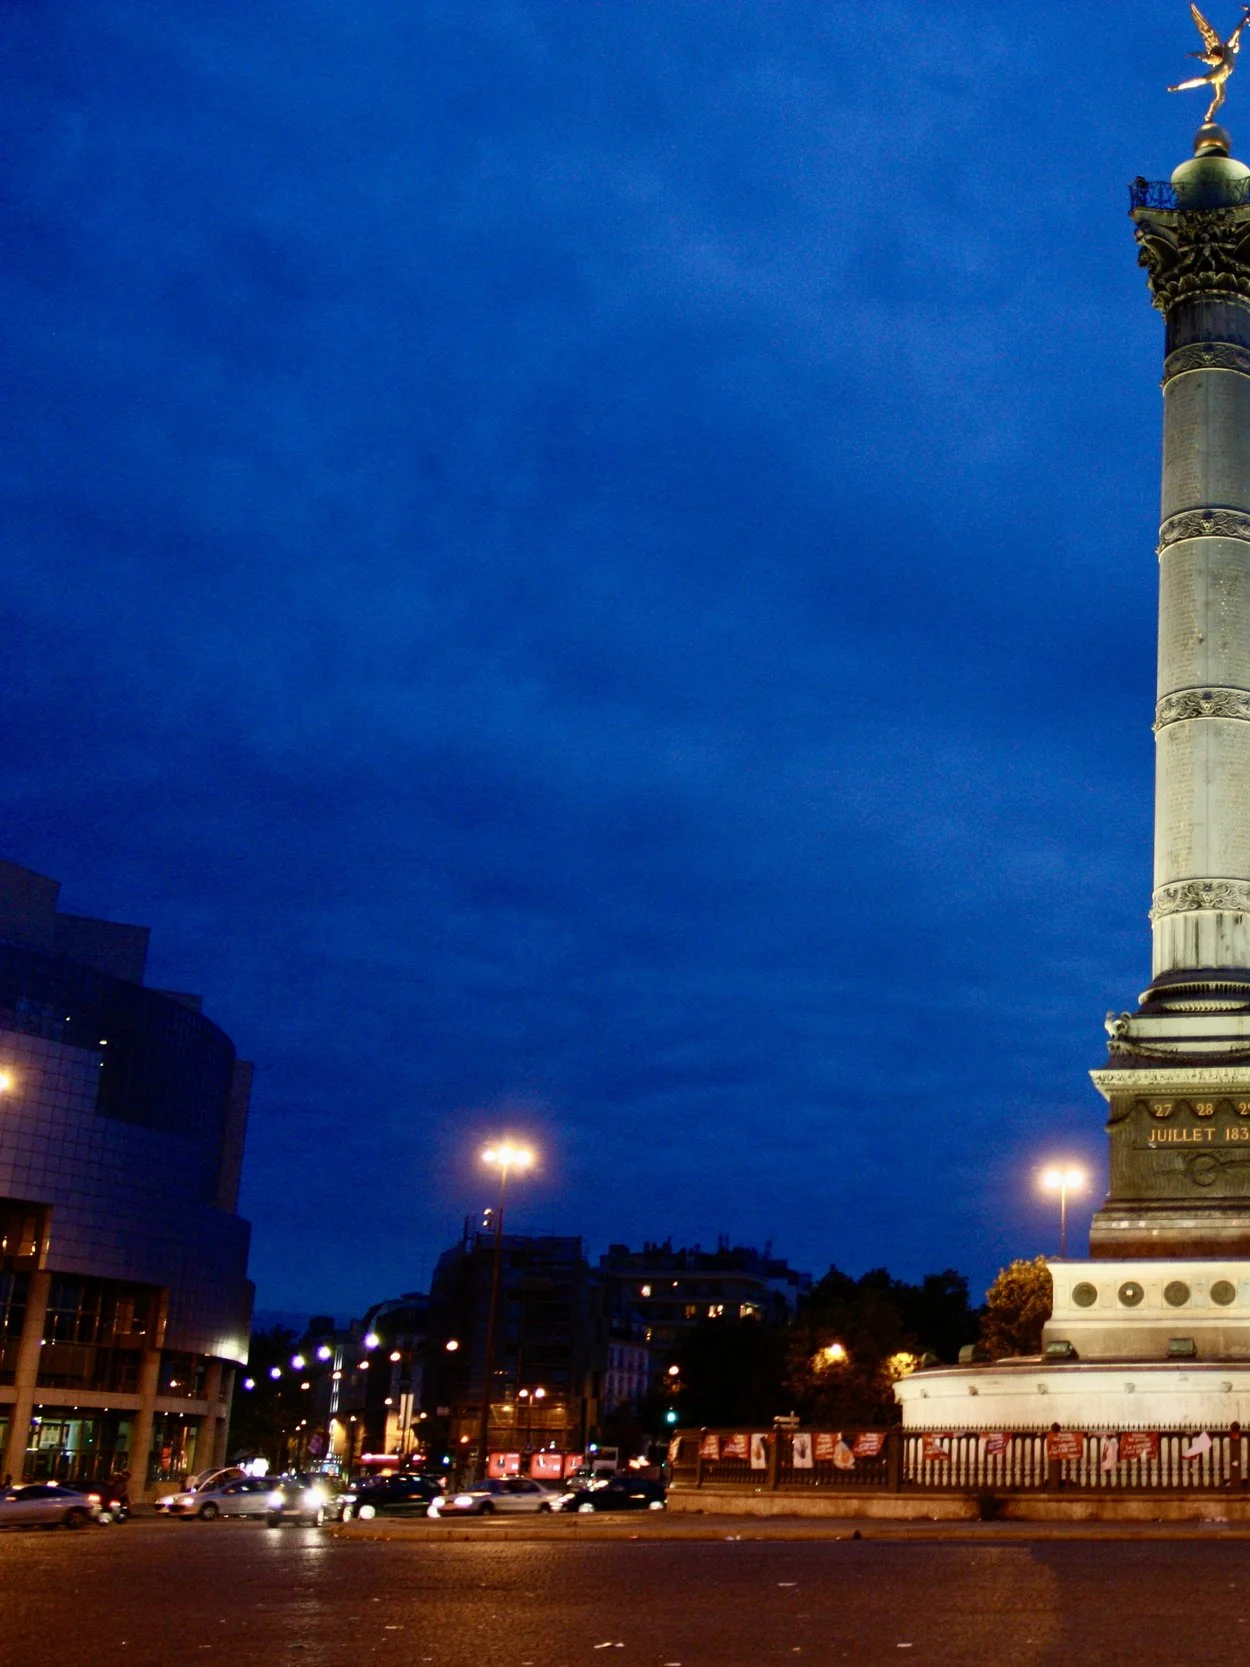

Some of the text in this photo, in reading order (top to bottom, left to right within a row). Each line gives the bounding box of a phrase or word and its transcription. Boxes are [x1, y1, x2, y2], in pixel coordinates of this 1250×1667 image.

[1154, 1104, 1172, 1117] 27
[1197, 1103, 1214, 1116] 28
[1148, 1128, 1216, 1142] JUILLET
